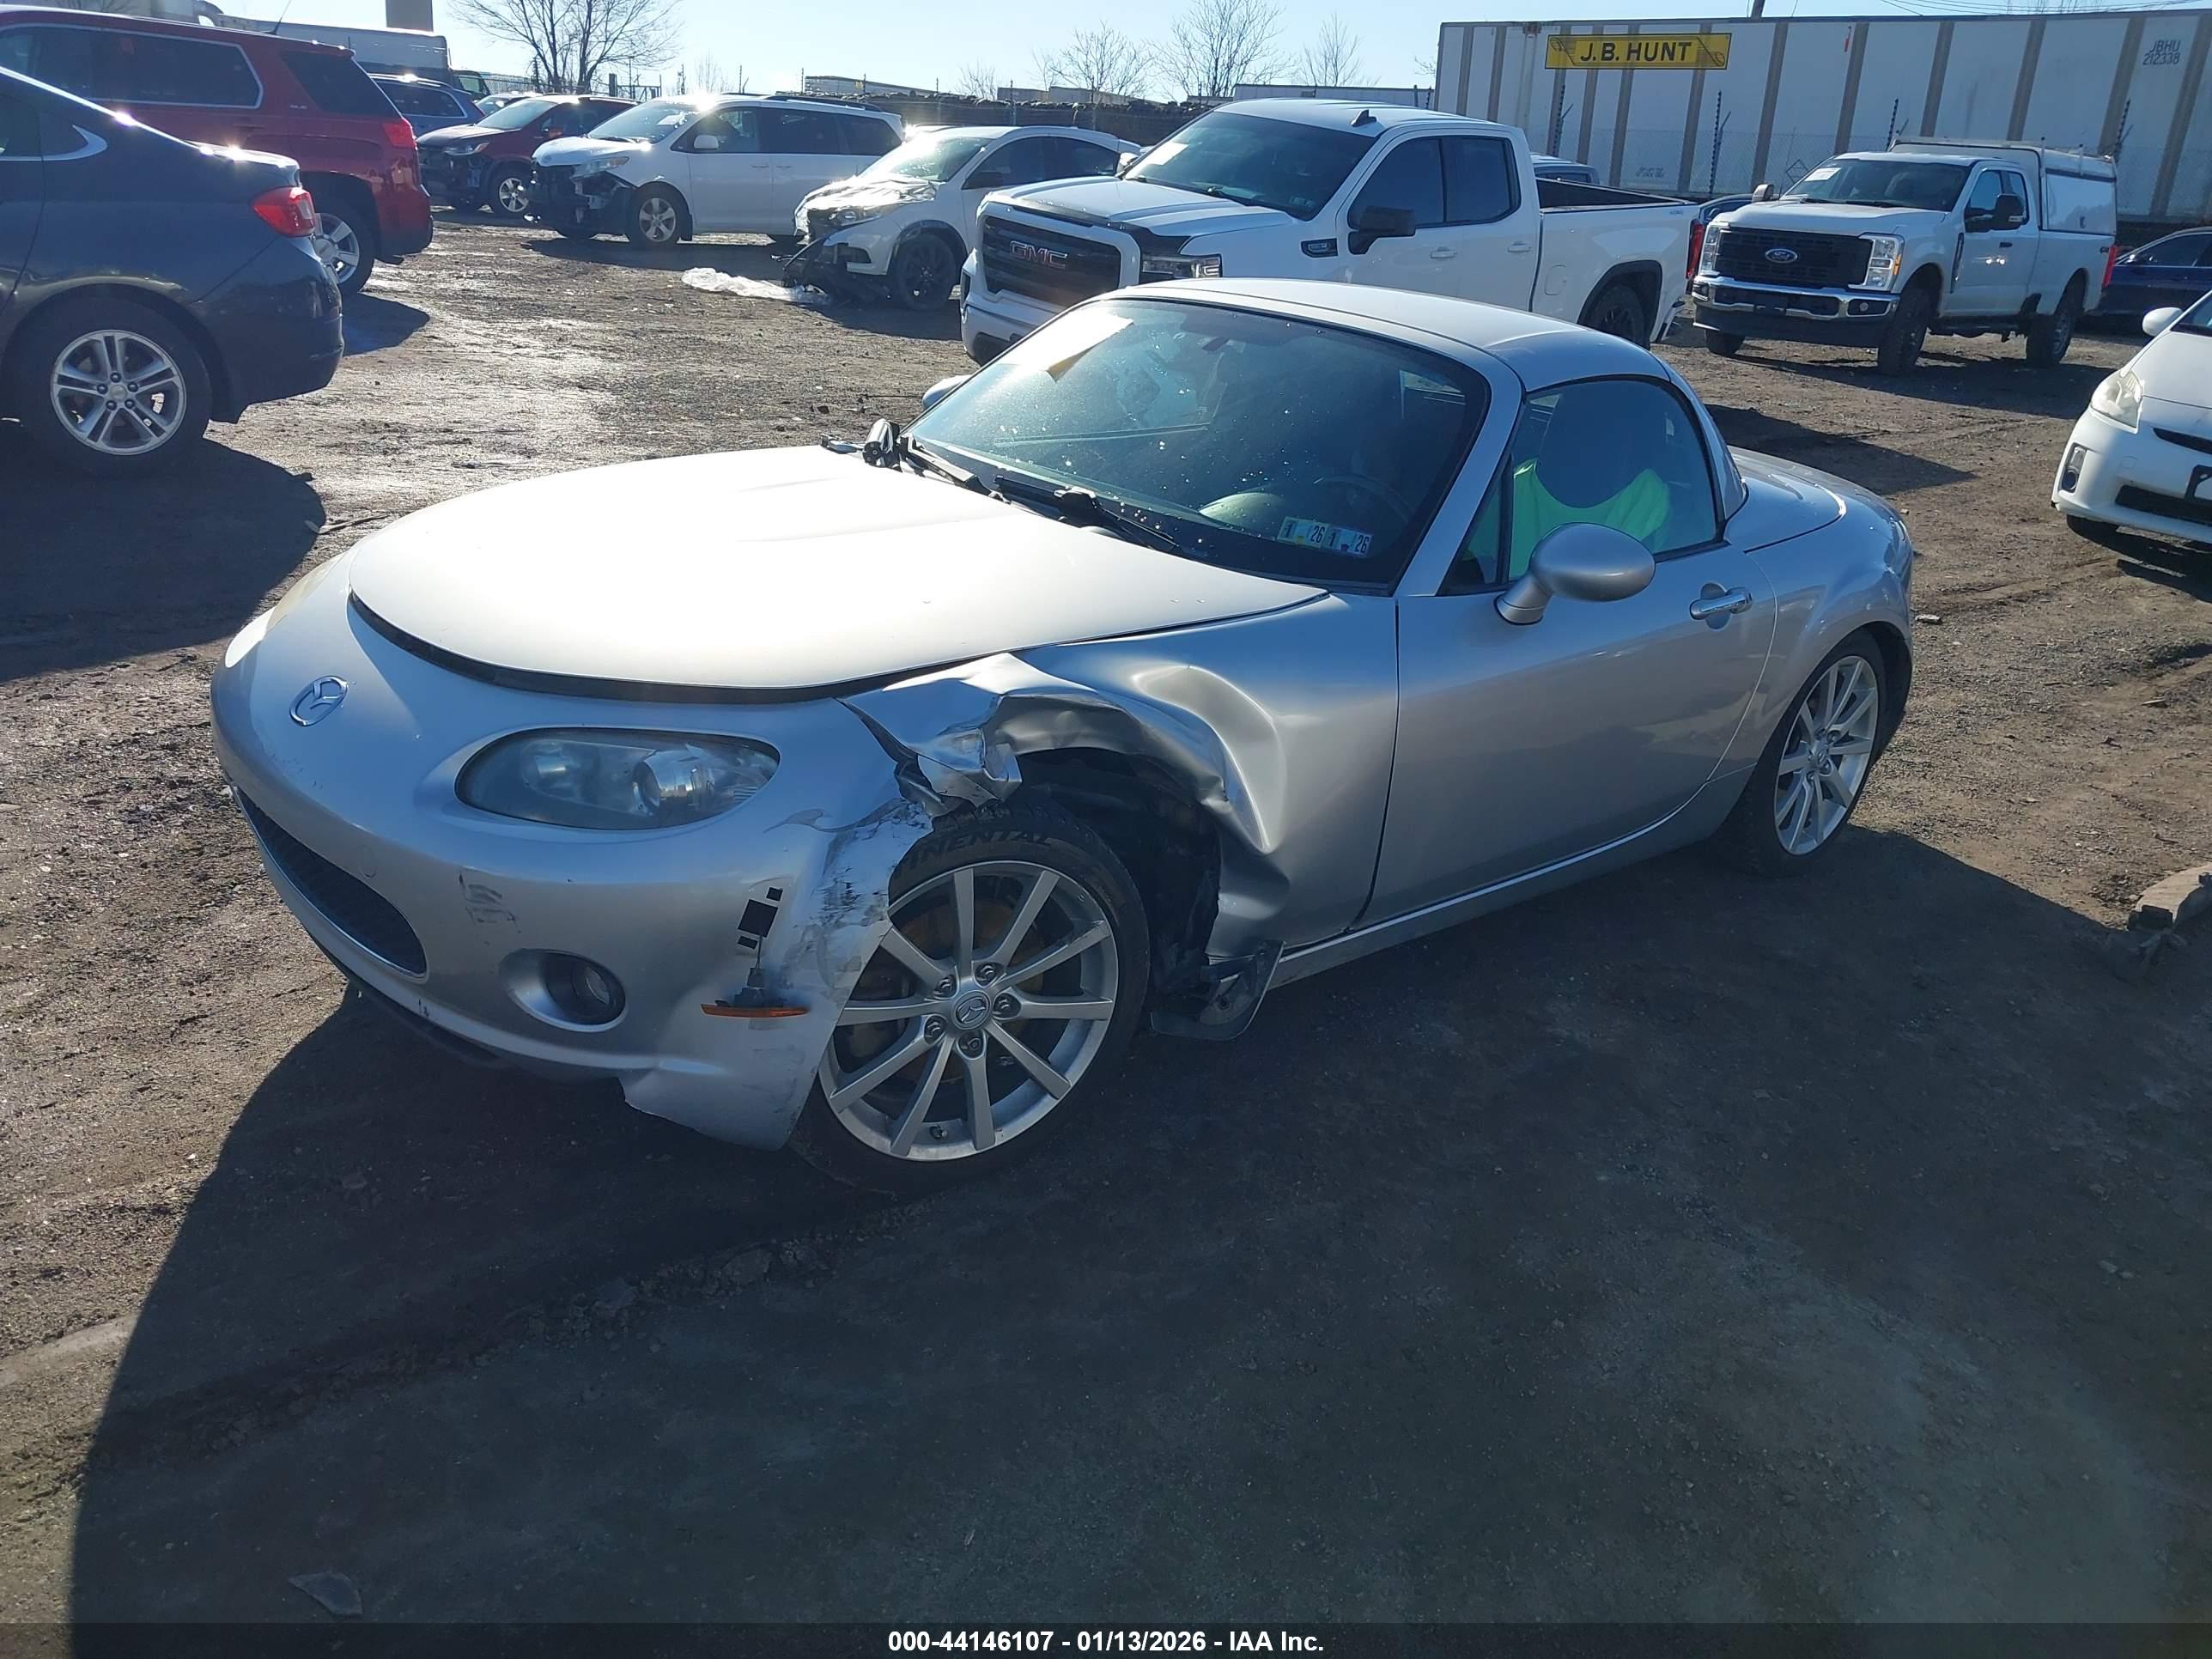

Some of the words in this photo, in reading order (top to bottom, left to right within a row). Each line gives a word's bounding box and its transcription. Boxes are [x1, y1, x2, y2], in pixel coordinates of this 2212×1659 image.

[1626, 41, 1692, 62] HUNT
[2149, 40, 2182, 53] JBHU
[2142, 52, 2181, 65] 212338
[1010, 240, 1068, 270] GMC
[1310, 525, 1326, 544] 26
[1354, 534, 1370, 553] 26
